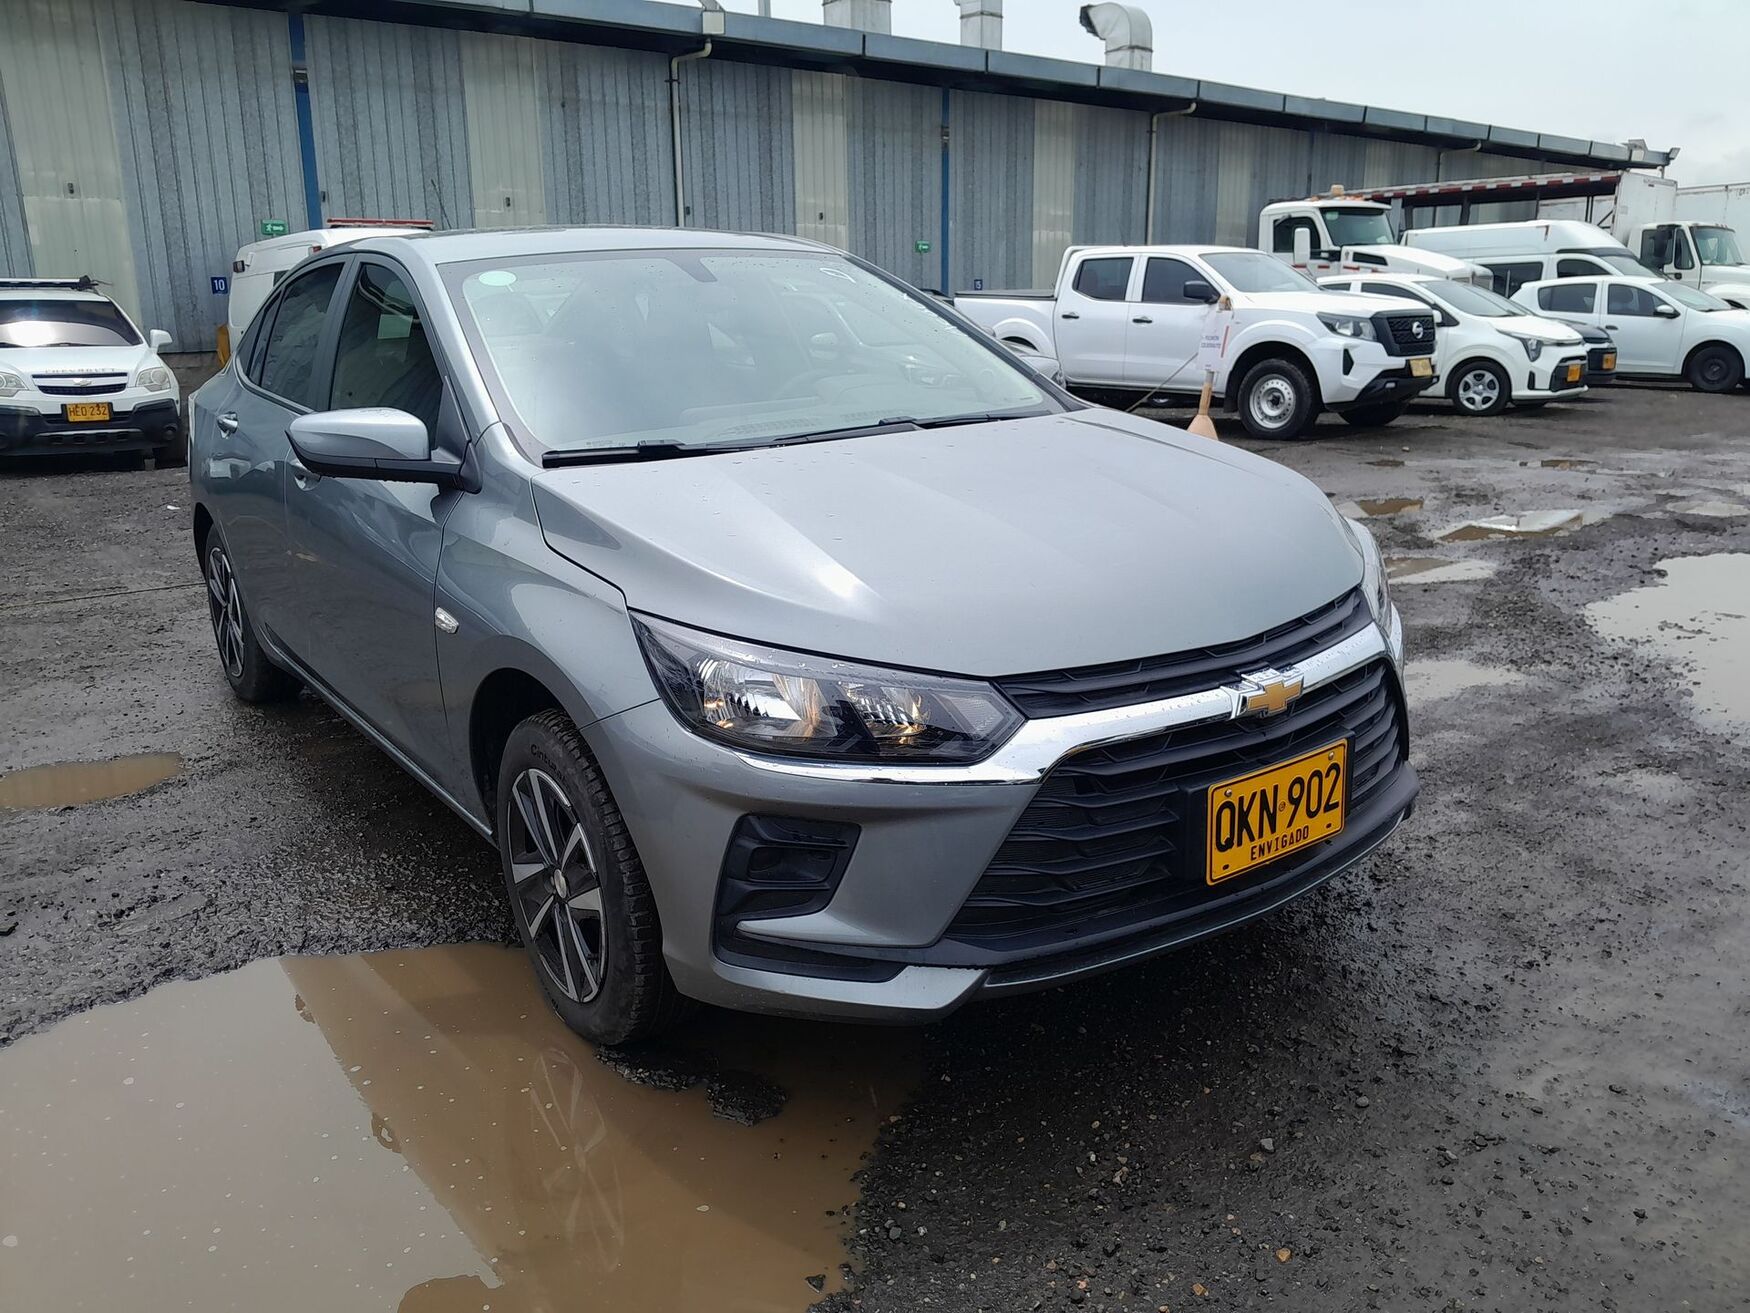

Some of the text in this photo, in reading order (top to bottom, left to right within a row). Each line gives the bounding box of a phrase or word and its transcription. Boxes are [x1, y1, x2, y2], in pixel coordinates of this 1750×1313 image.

[213, 279, 225, 291] 10
[90, 405, 107, 416] 232
[1215, 762, 1341, 852] QKN 902
[1250, 825, 1310, 861] ENVIGADO
